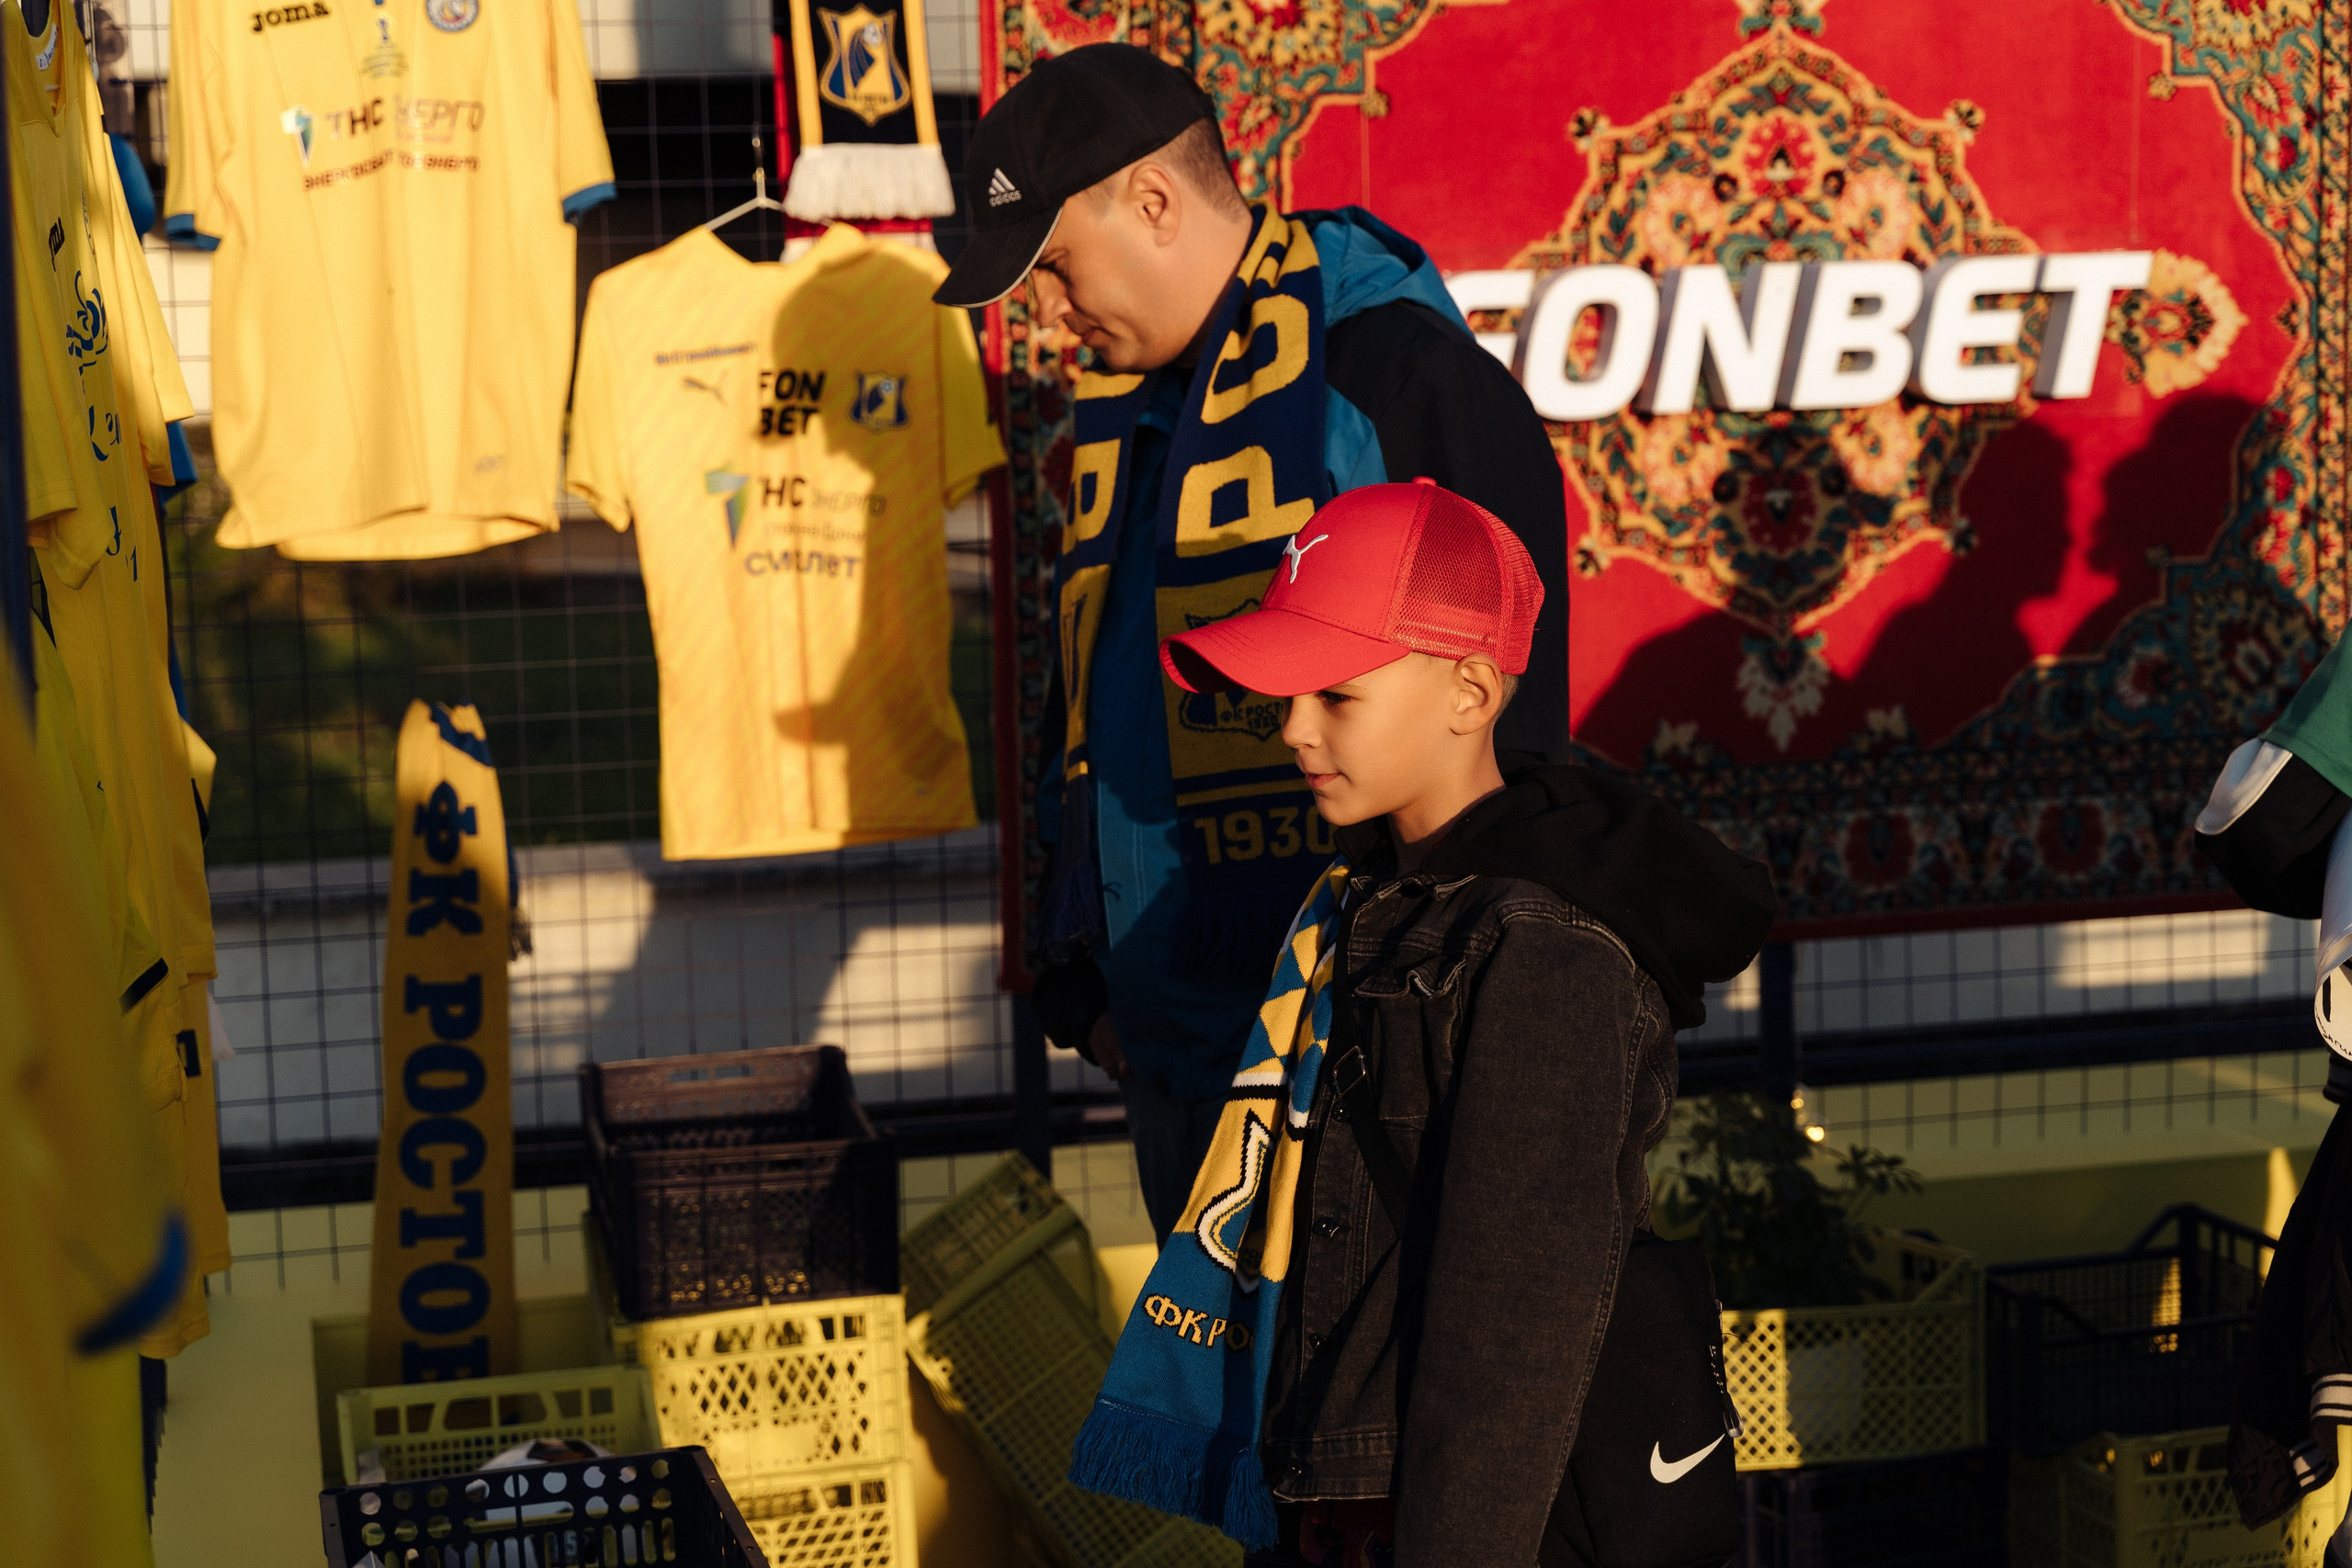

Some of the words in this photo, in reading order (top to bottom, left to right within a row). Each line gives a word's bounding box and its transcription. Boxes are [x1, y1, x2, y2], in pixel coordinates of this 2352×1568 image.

[760, 368, 826, 401] FON
[760, 404, 820, 436] BET
[758, 474, 806, 507] НС
[1246, 702, 1284, 719] РОСТ
[1193, 804, 1338, 865] 1930
[406, 780, 484, 940] ФК
